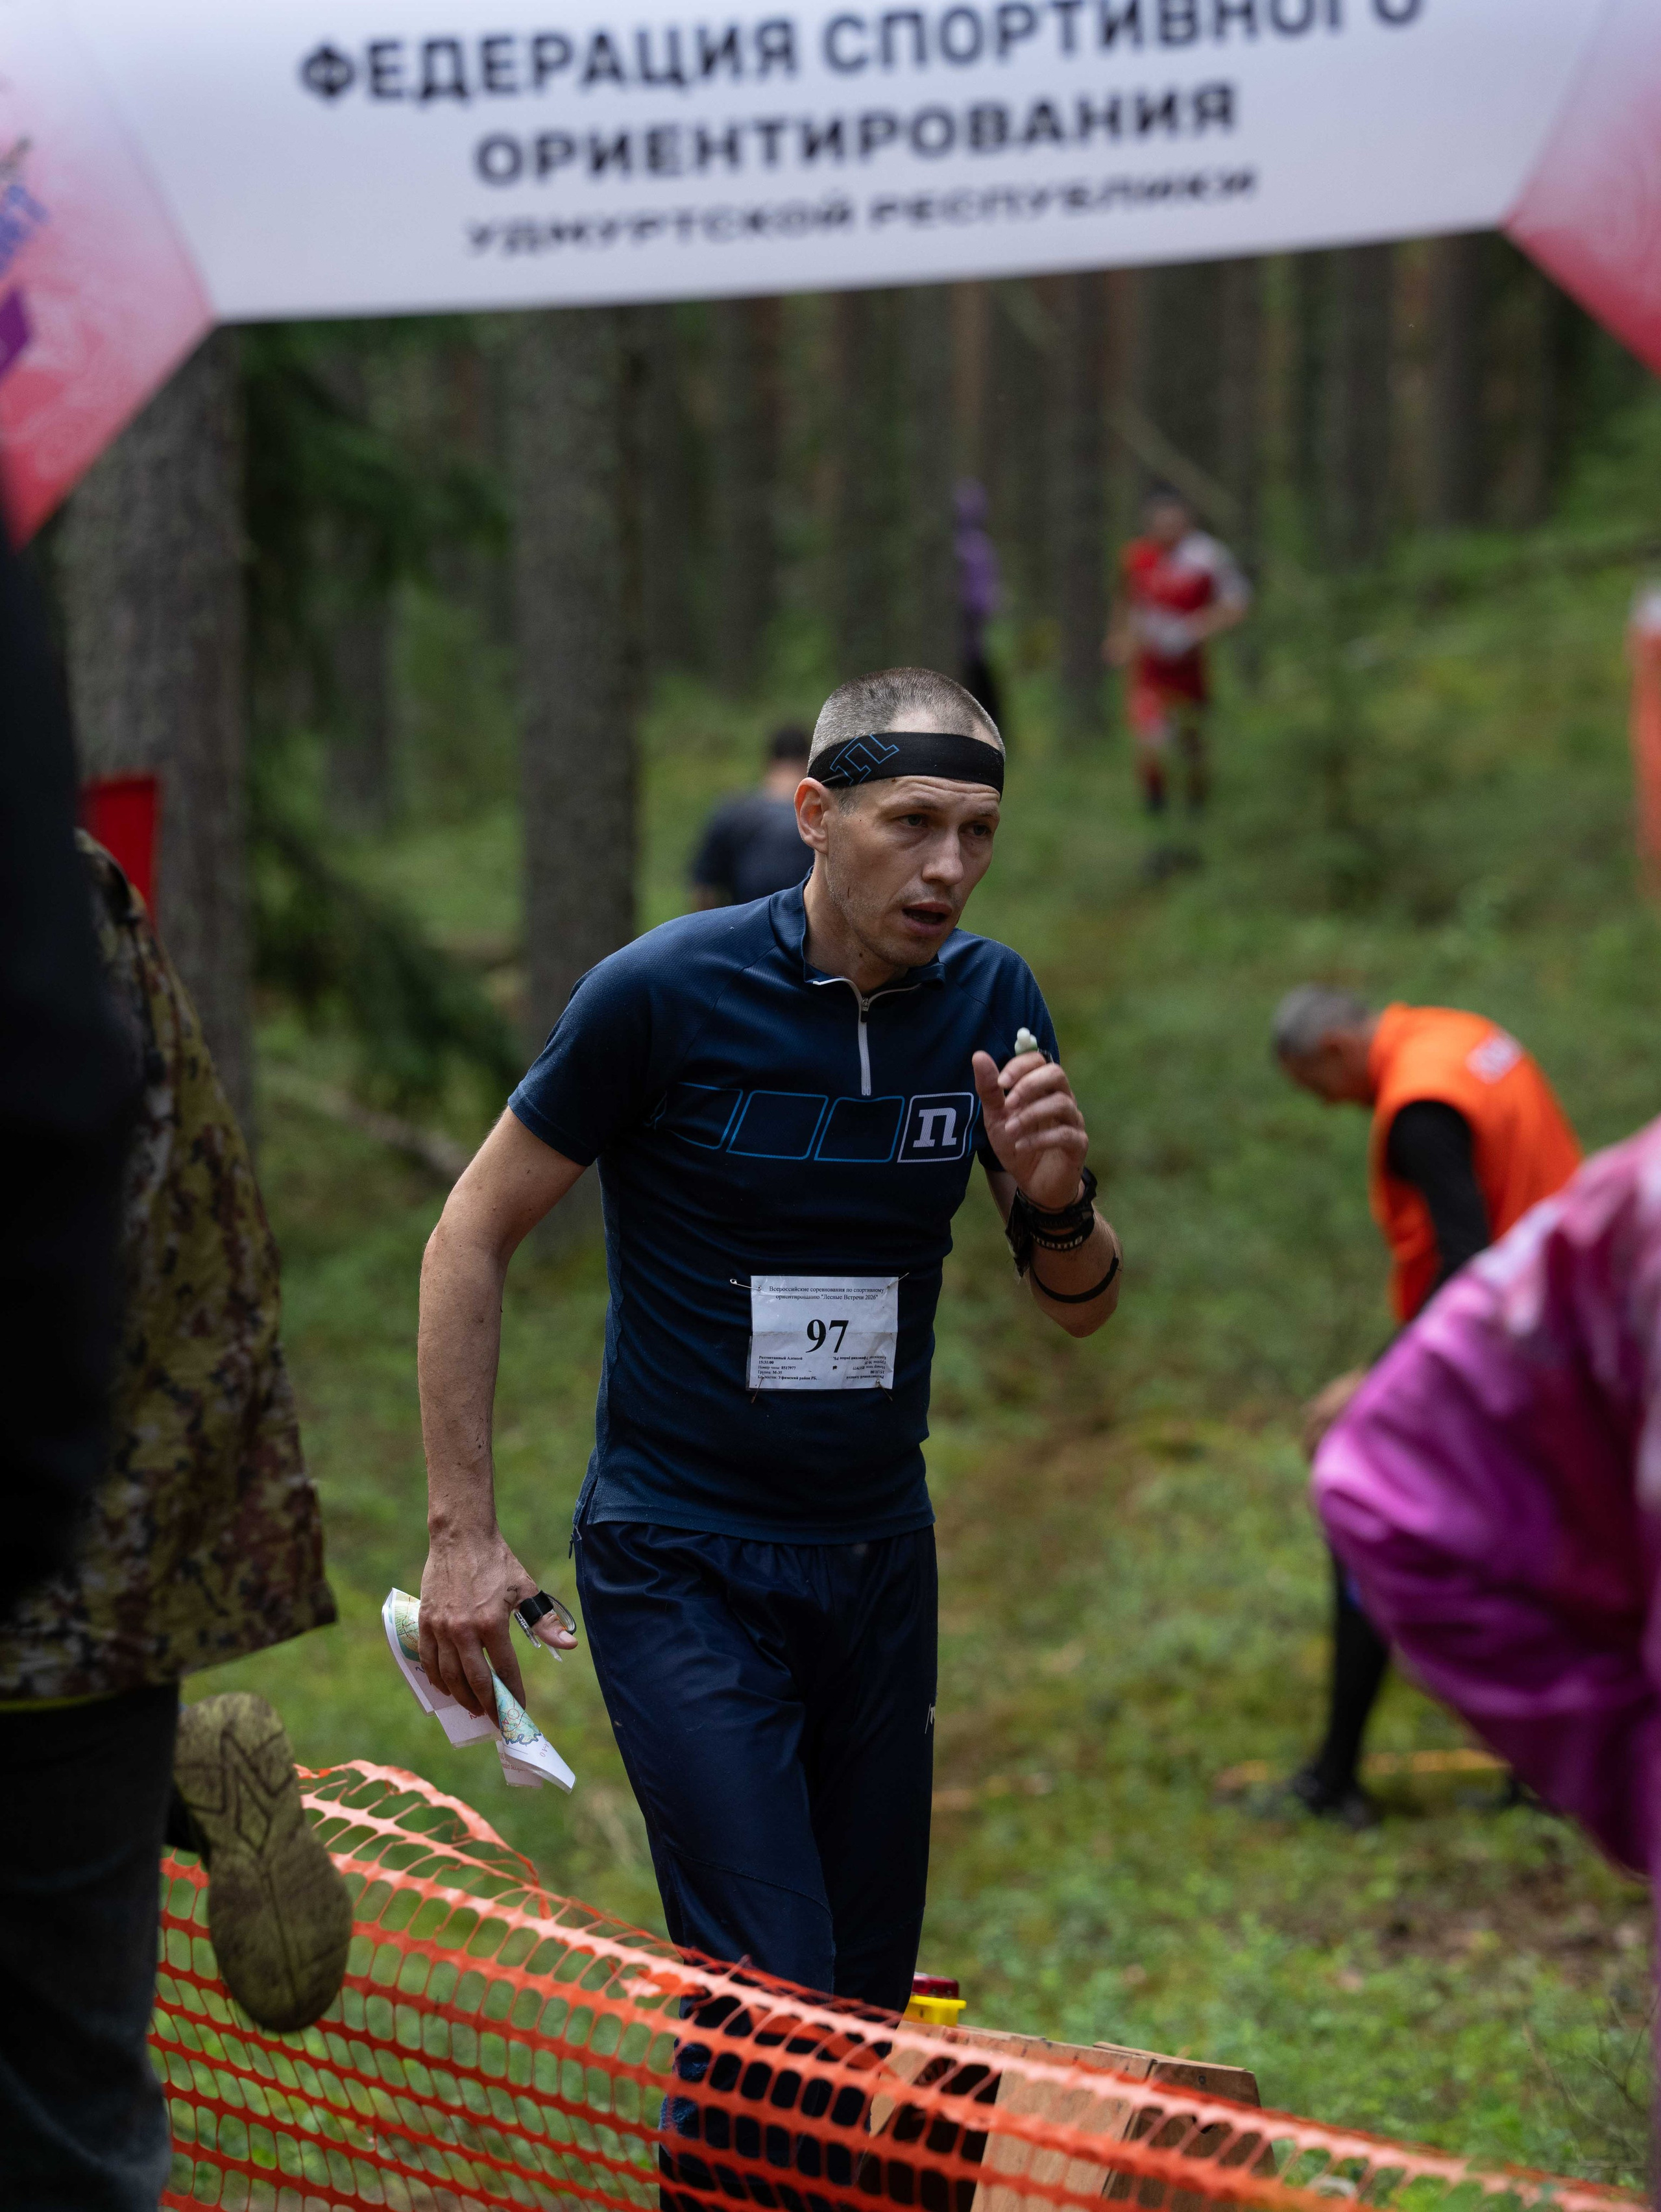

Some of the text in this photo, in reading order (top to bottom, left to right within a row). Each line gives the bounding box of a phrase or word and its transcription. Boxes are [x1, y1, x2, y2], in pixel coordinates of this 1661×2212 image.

[299, 18, 797, 108] ФЕДЕРАЦИЯ
[476, 80, 1237, 186] ОРИЕНТИРОВАНИЯ
[467, 166, 1255, 256] УДМУРТСКОЙ РЕСПУБЛИКИ
[805, 1319, 849, 1353] 97
